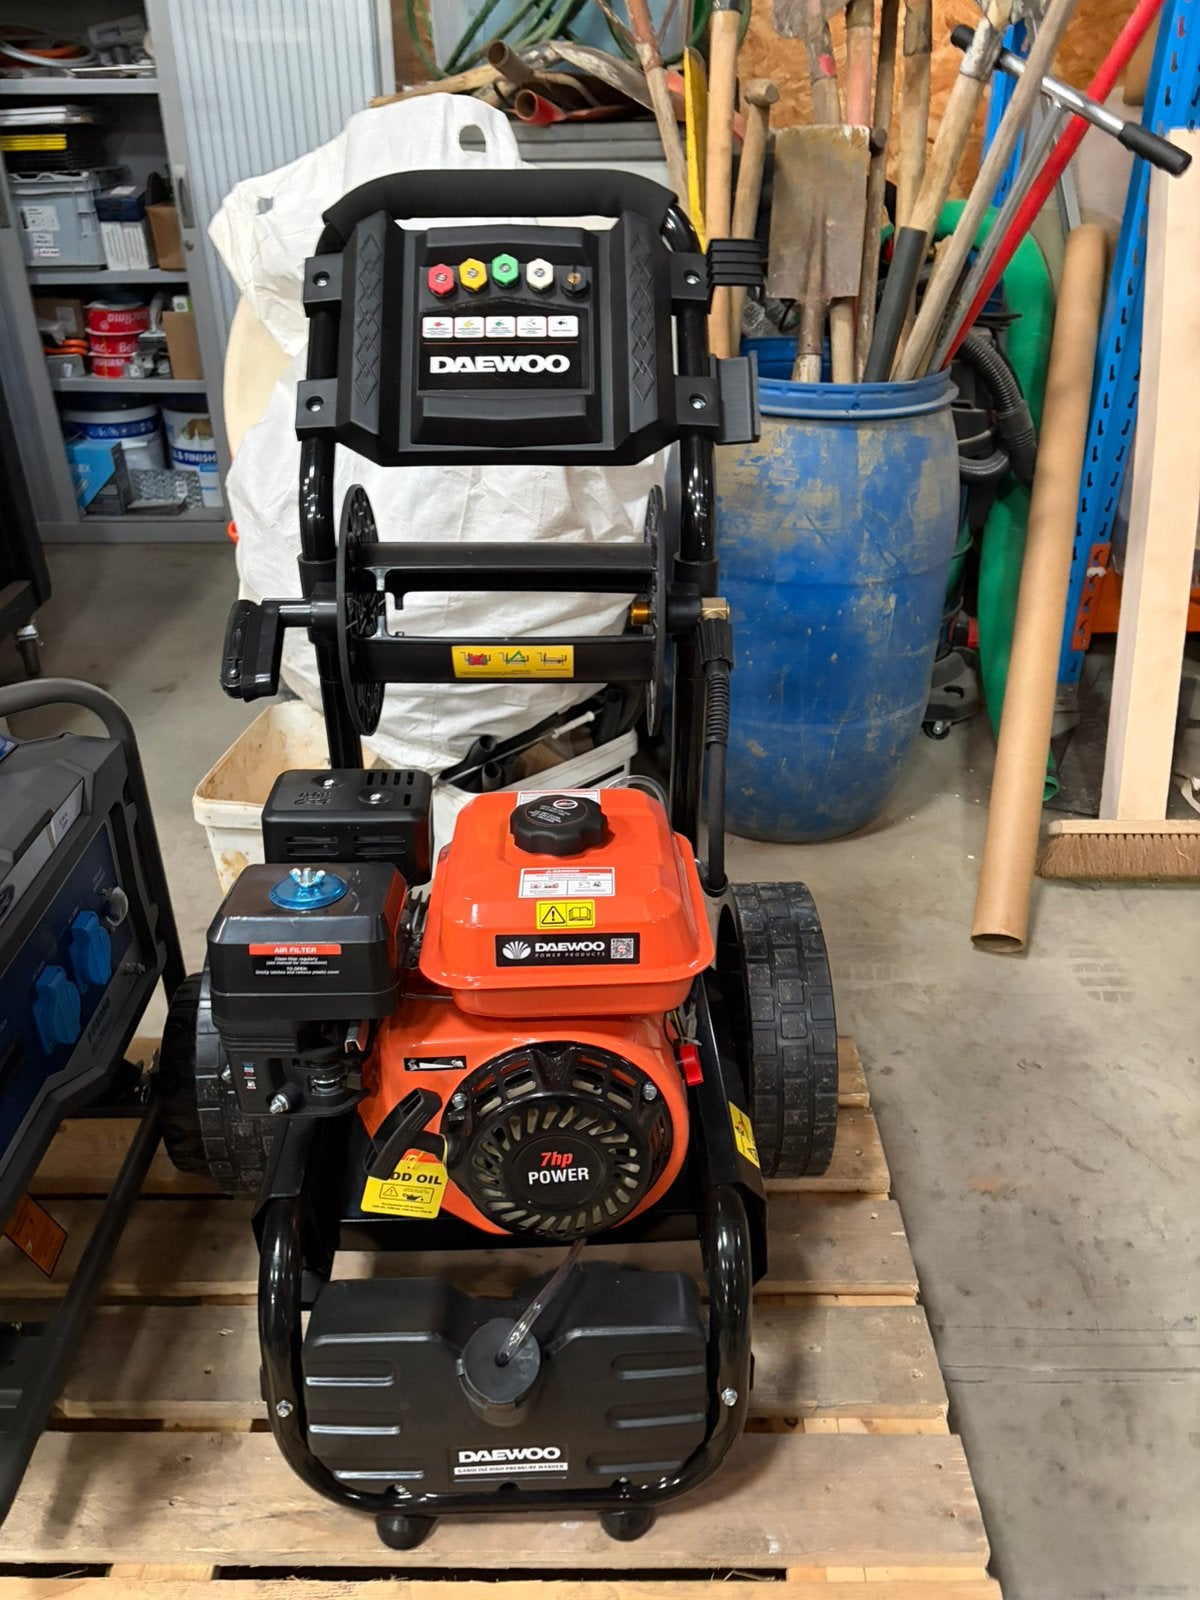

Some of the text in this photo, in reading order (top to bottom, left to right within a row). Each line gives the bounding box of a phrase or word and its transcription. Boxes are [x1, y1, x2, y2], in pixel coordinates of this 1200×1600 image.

[429, 354, 571, 374] DAEWOO
[535, 941, 605, 952] DAEWOO
[540, 1151, 573, 1168] 7hp
[416, 1173, 442, 1185] OIL
[528, 1167, 589, 1185] POWER
[458, 1447, 561, 1463] DAEWOO
